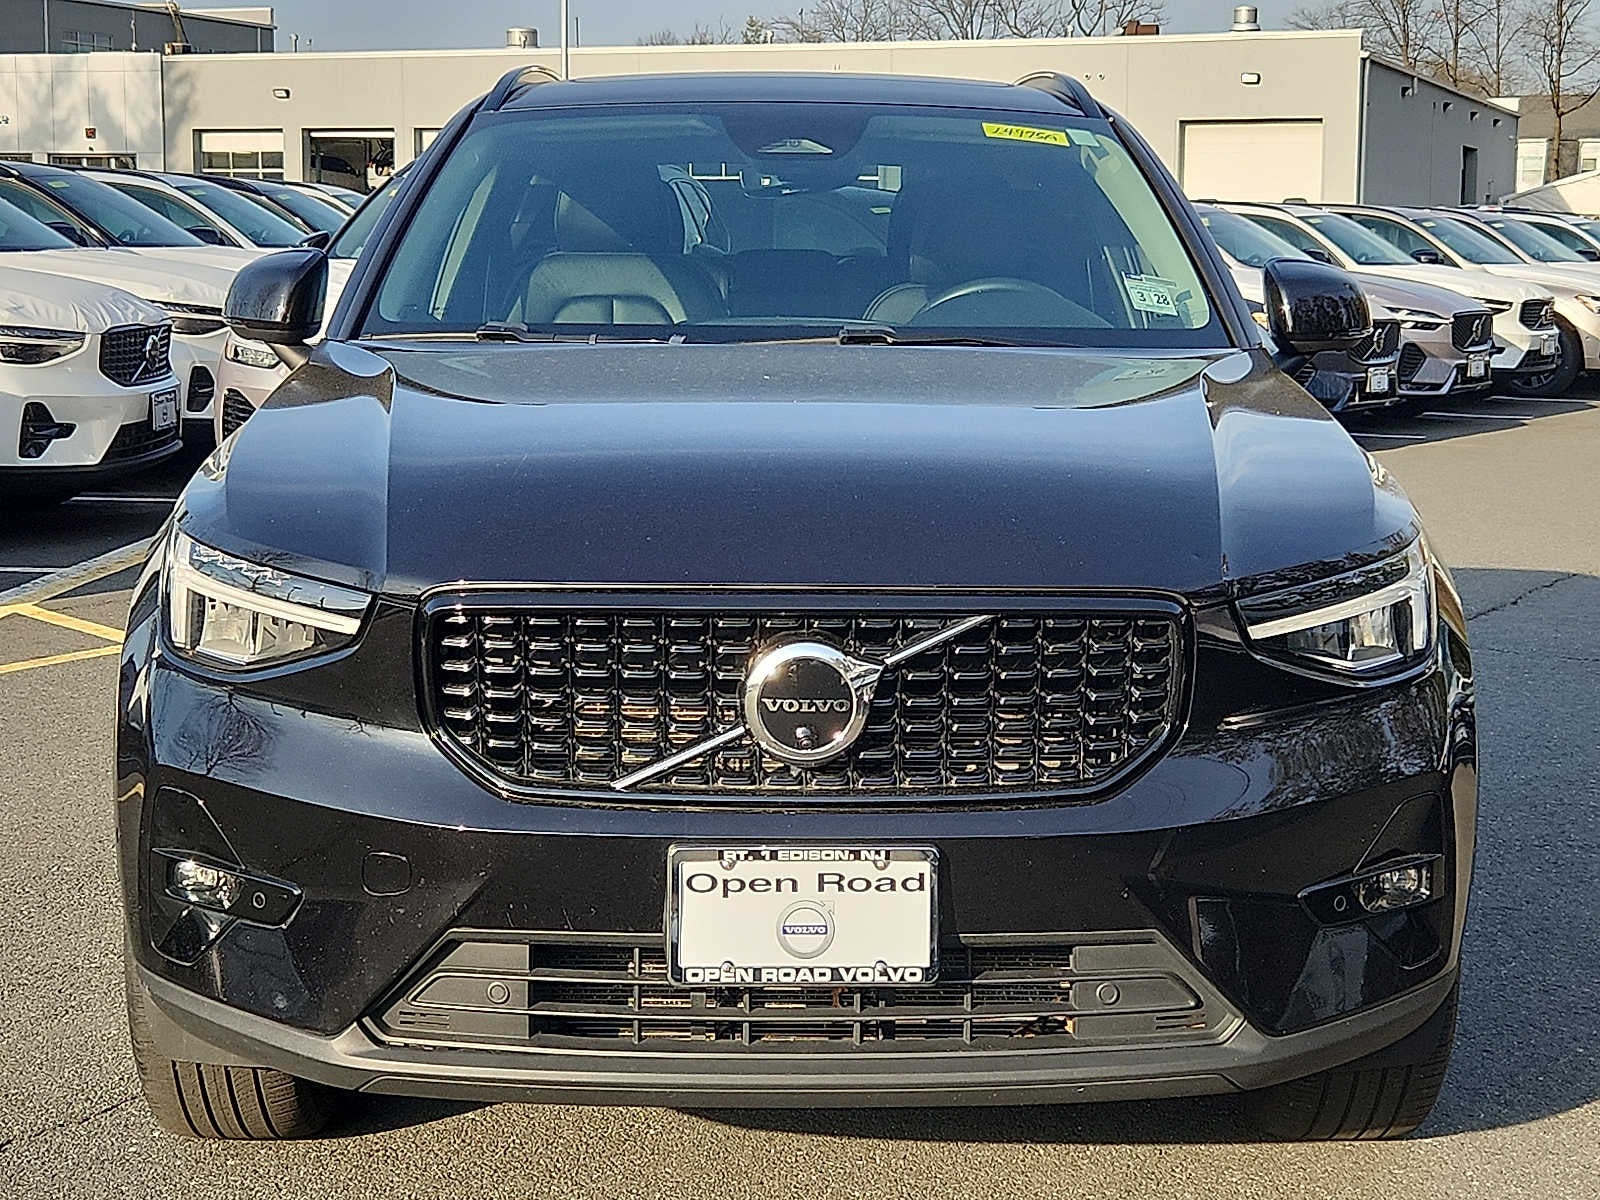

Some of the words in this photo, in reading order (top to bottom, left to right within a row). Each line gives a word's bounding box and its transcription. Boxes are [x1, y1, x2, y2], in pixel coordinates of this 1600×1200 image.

[1137, 291, 1147, 302] 3
[1153, 294, 1170, 306] 28
[761, 698, 850, 713] VOLVO
[762, 849, 771, 861] 1
[777, 849, 855, 862] EDISON,
[861, 849, 886, 861] NJ
[686, 873, 798, 898] Open
[817, 872, 925, 893] Road
[783, 925, 827, 935] VOLVO
[685, 967, 754, 983] OPEN
[760, 967, 832, 983] ROAD
[837, 967, 923, 983] VOLVO
